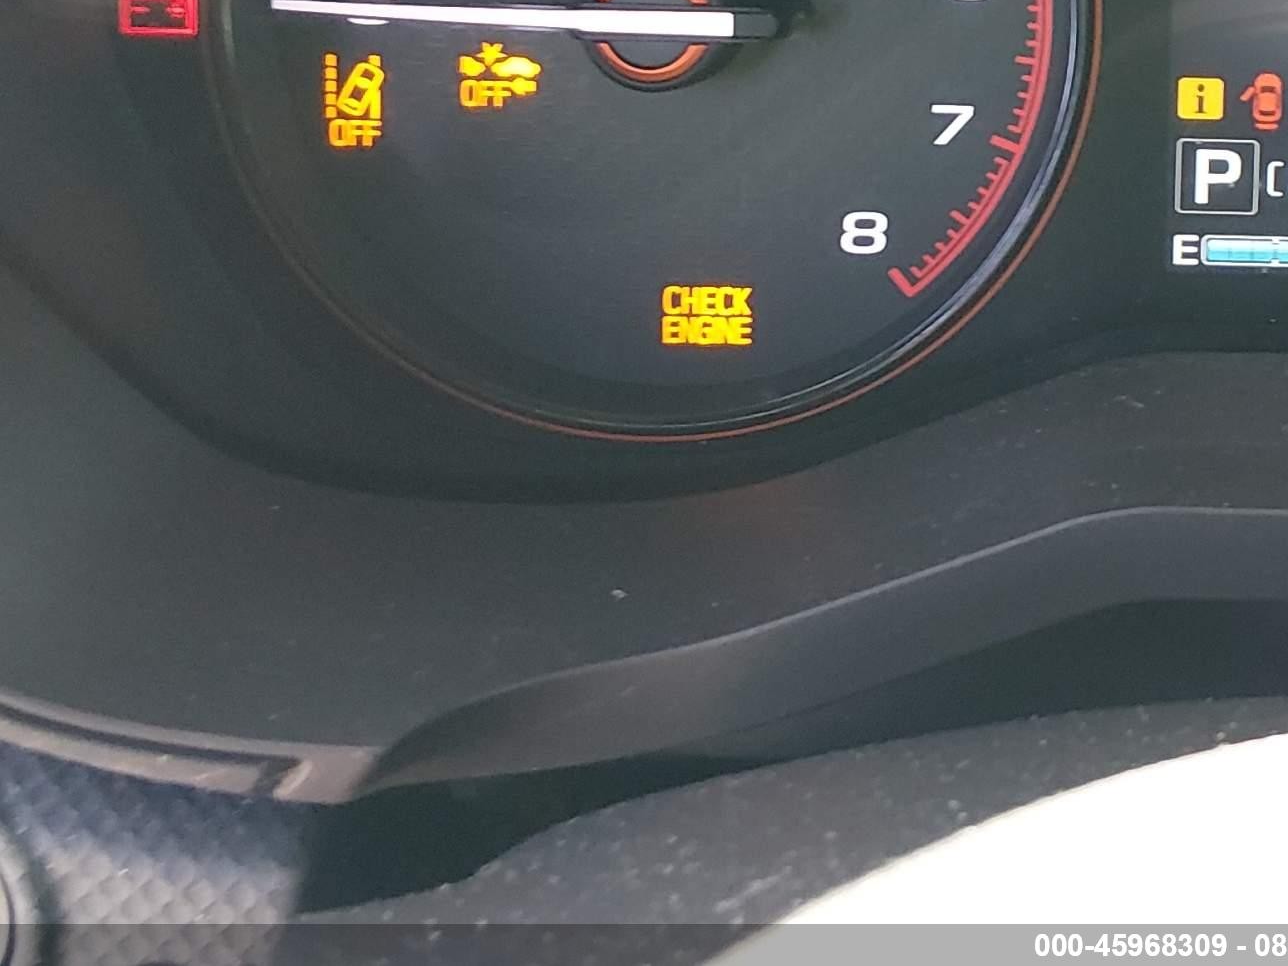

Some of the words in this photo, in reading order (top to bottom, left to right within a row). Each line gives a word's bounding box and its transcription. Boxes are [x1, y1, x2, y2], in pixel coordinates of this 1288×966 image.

[327, 119, 383, 147] OFF
[931, 104, 975, 145] 7
[1193, 148, 1243, 205] P
[840, 211, 888, 255] 8
[1172, 234, 1199, 265] E
[661, 285, 753, 316] CHECK
[661, 317, 753, 346] ENGINE
